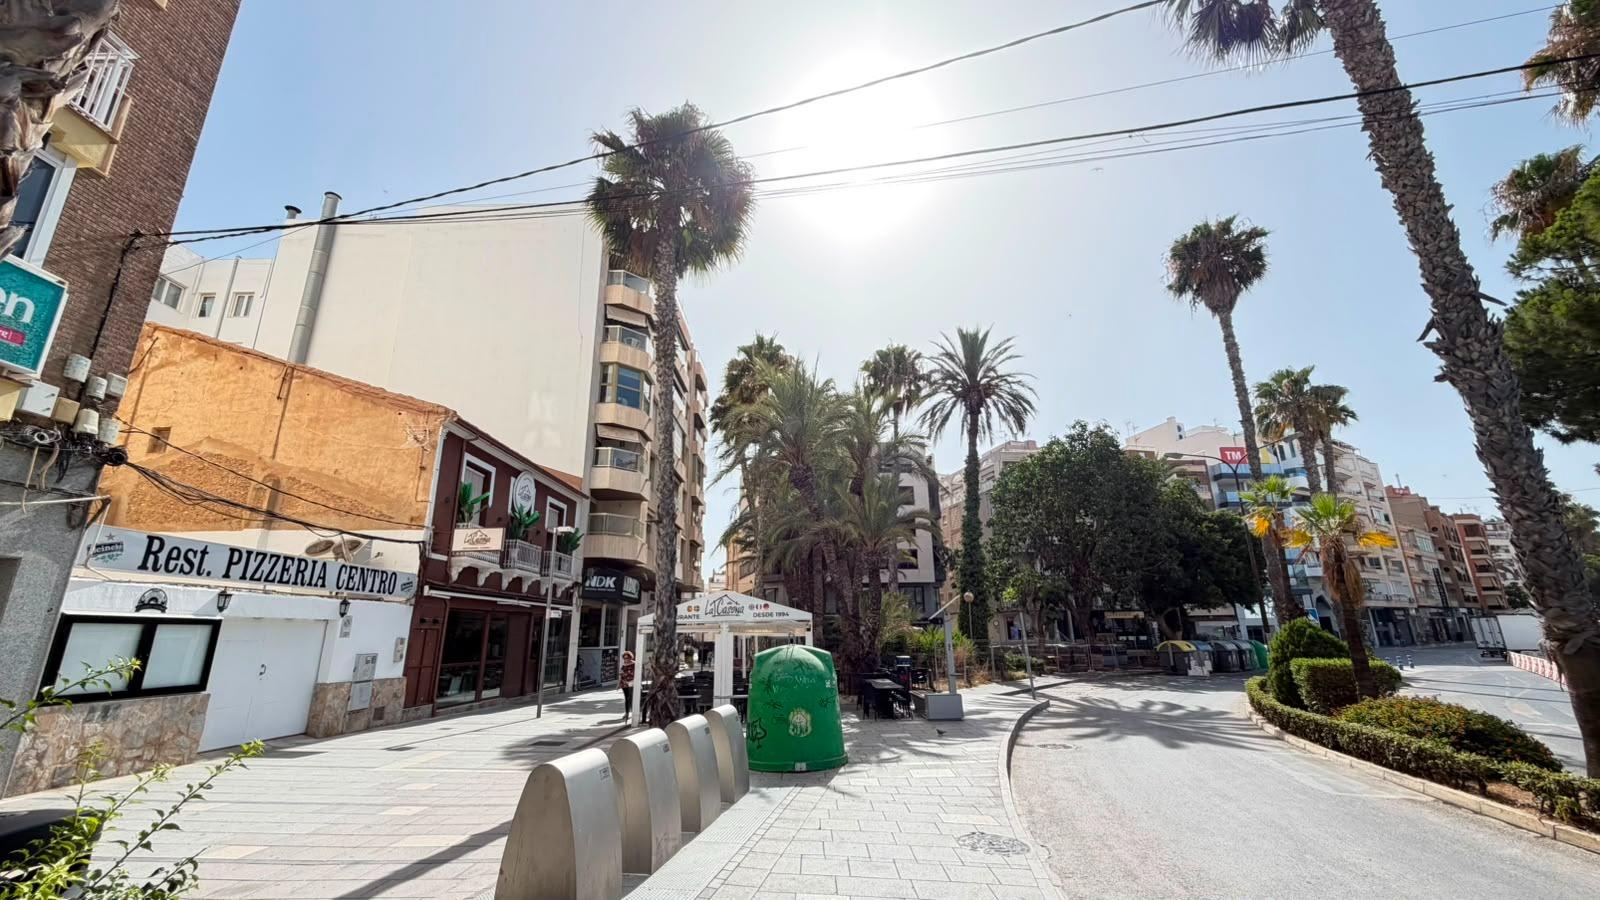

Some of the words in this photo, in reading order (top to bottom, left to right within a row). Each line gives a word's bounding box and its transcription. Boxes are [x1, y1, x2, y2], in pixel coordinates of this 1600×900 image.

[1224, 451, 1242, 460] TM
[138, 535, 212, 577] Rest.
[222, 547, 327, 588] PIZZERIA
[336, 563, 397, 595] CENTRO
[585, 576, 616, 588] NDK
